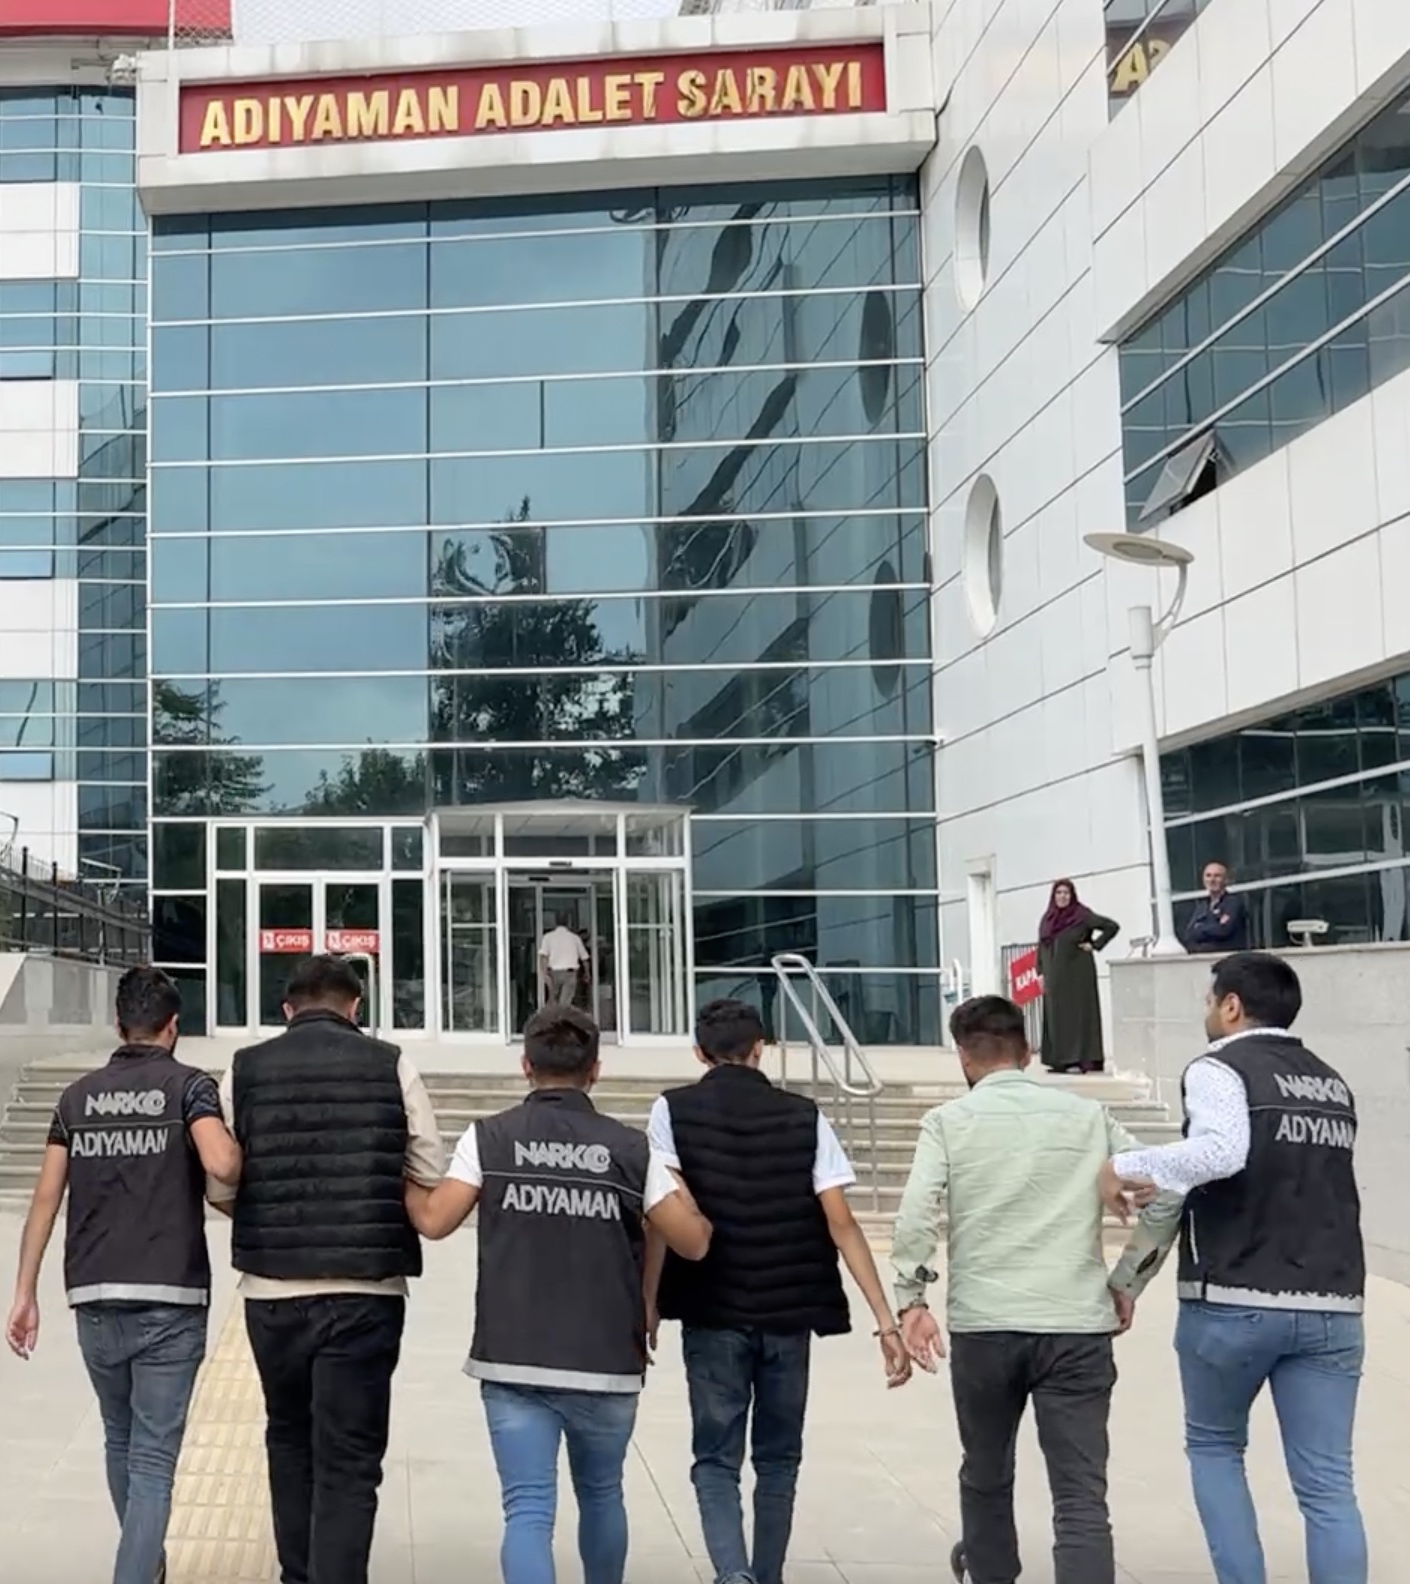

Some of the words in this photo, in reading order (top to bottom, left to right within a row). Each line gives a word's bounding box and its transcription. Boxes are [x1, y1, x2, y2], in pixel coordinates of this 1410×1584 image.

[199, 86, 458, 147] ADIYAMAN
[475, 72, 664, 128] ADALET
[677, 62, 861, 117] SARAYI
[85, 1089, 166, 1116] NARKO
[71, 1128, 168, 1157] ADIYAMAN
[514, 1140, 610, 1173] NARKO
[502, 1183, 621, 1221] ADIYAMAN
